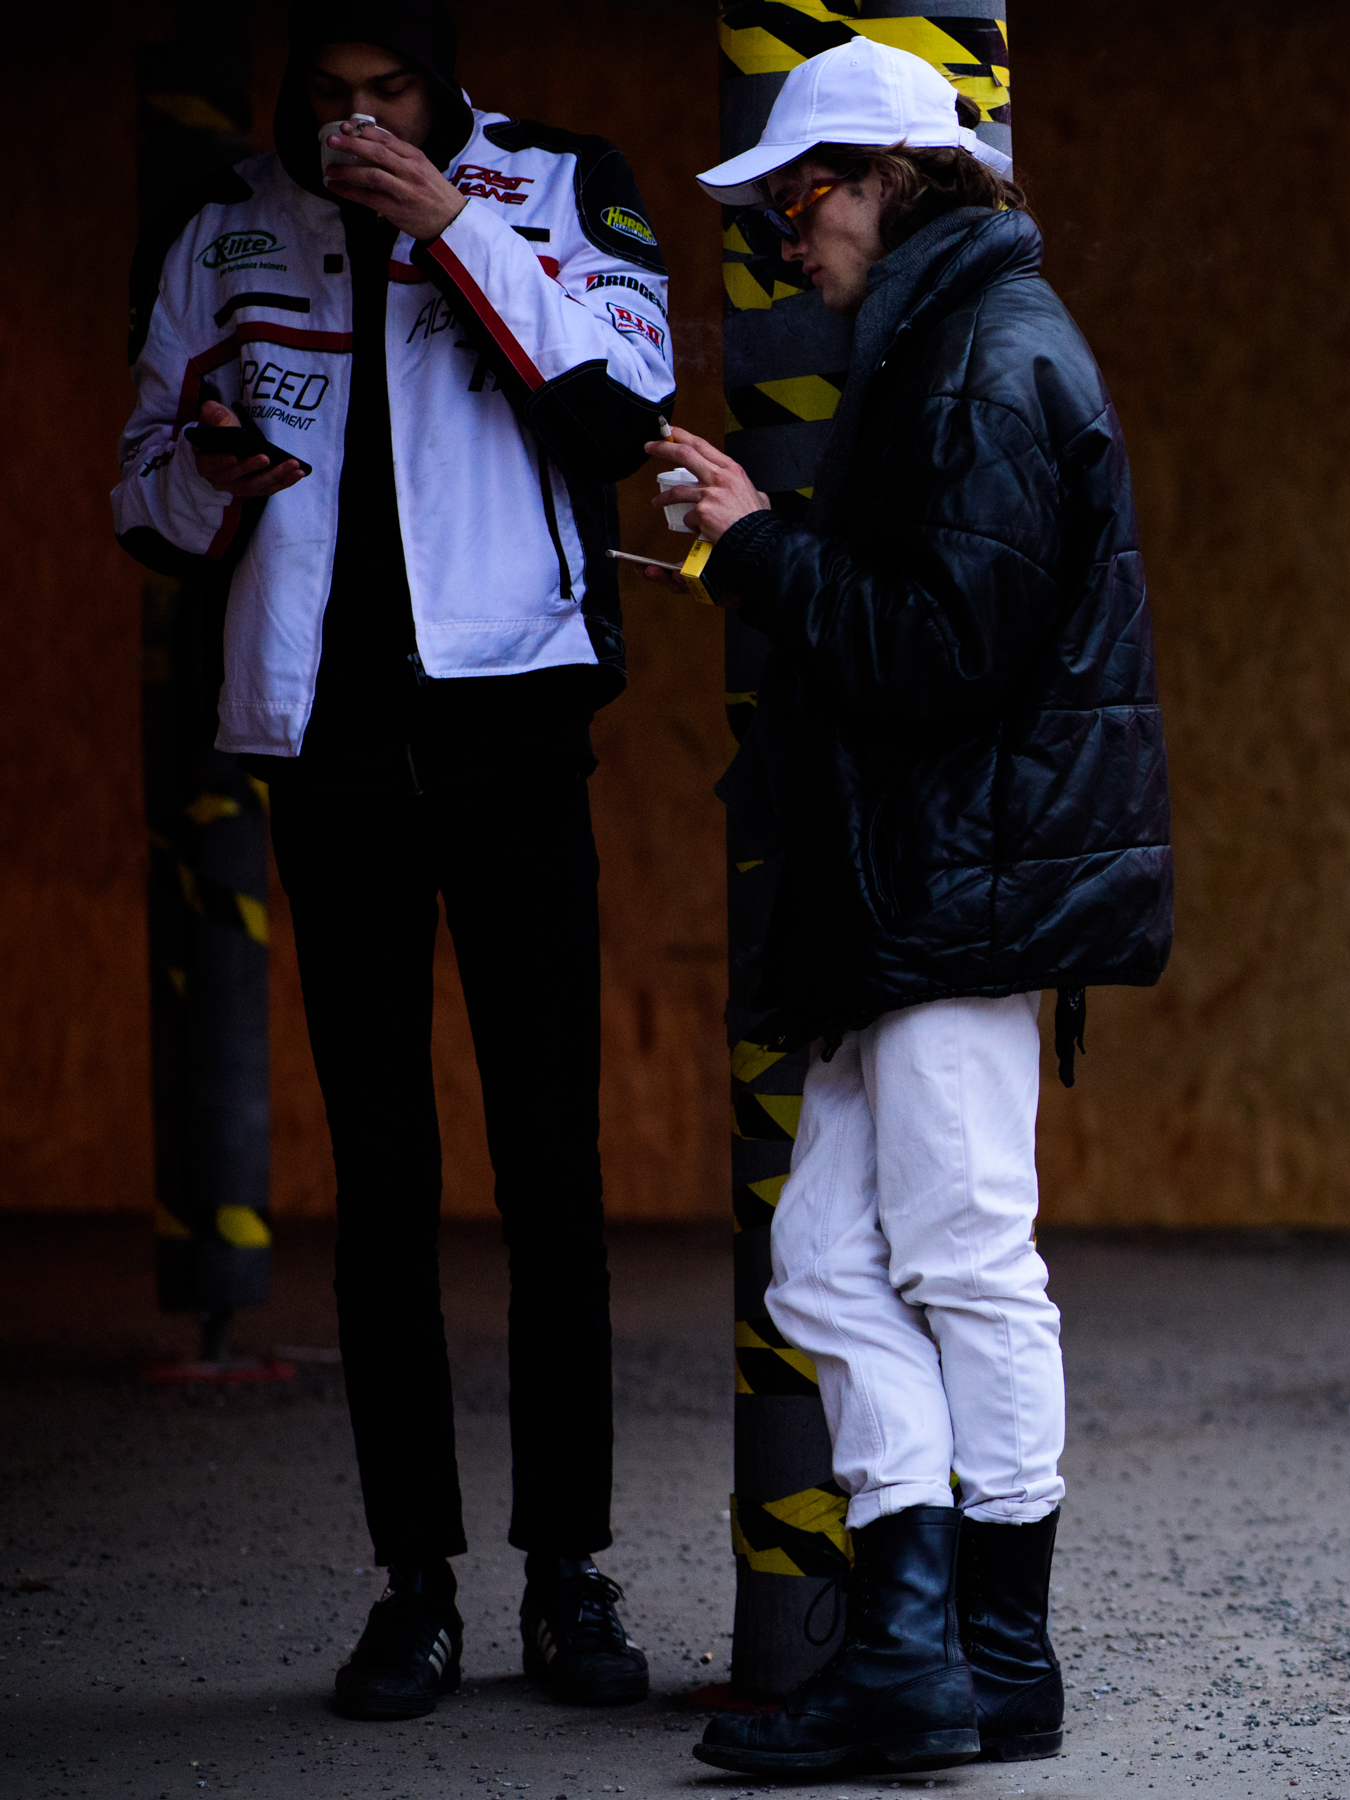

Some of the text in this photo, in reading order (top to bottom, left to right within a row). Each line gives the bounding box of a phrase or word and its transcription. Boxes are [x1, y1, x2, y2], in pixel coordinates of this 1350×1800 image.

[449, 164, 535, 191] FAST
[606, 205, 654, 240] HURRIC
[240, 360, 329, 412] PEED
[251, 405, 316, 431] EQUIPMENT
